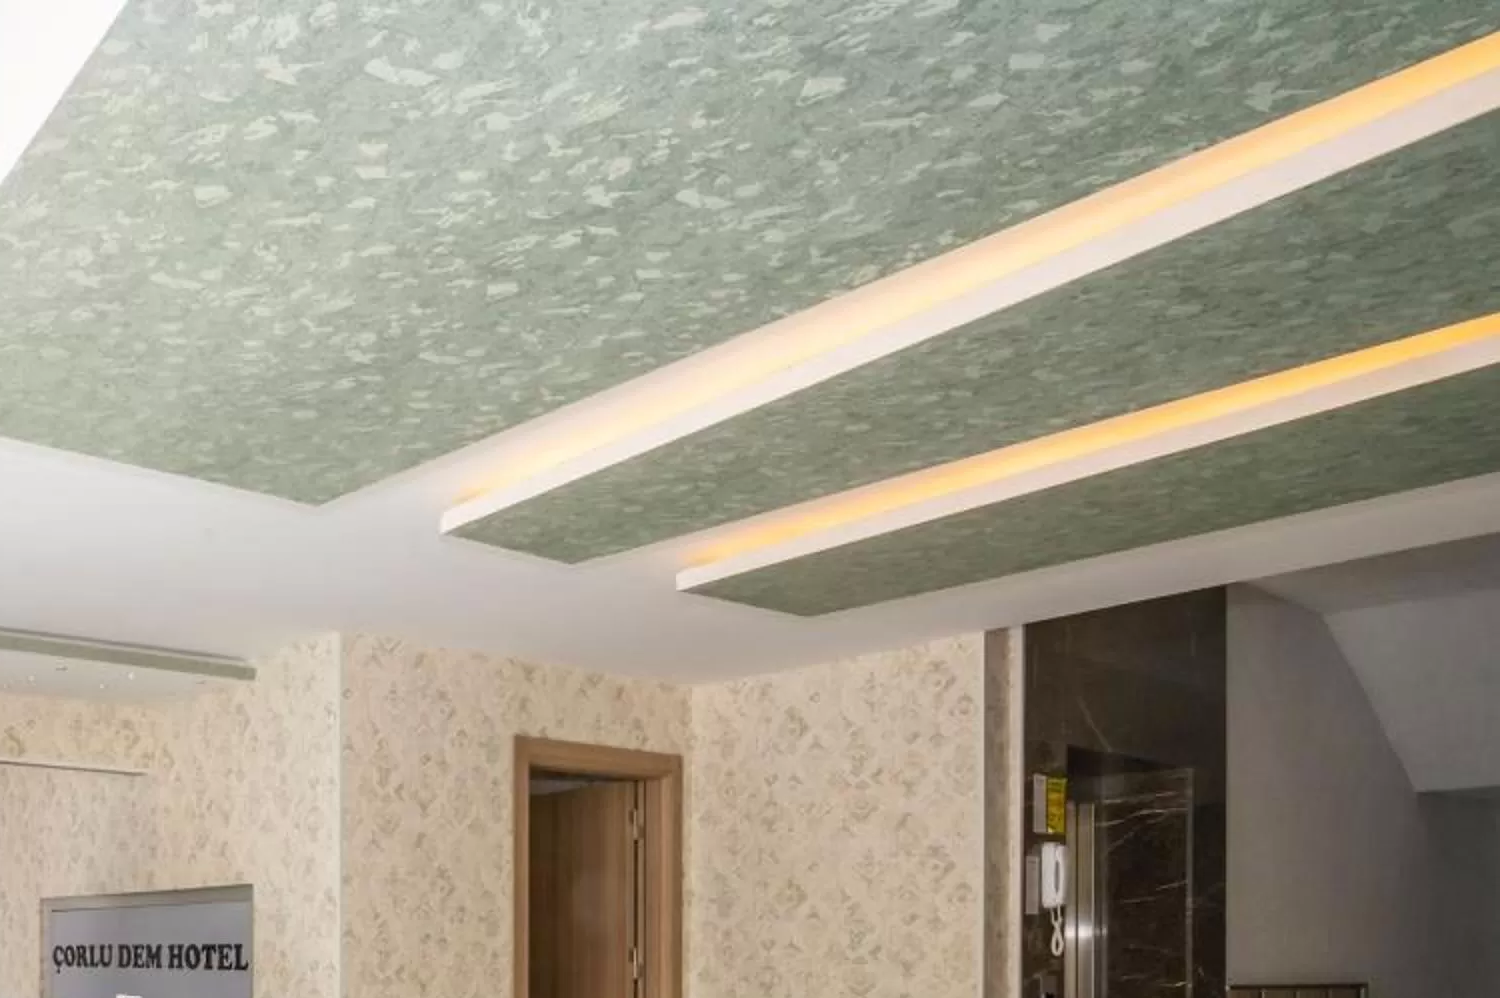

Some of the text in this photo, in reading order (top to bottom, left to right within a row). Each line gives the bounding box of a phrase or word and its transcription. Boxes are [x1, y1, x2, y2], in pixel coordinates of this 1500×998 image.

[53, 943, 249, 974] ÇORLU DEM HOTEL
